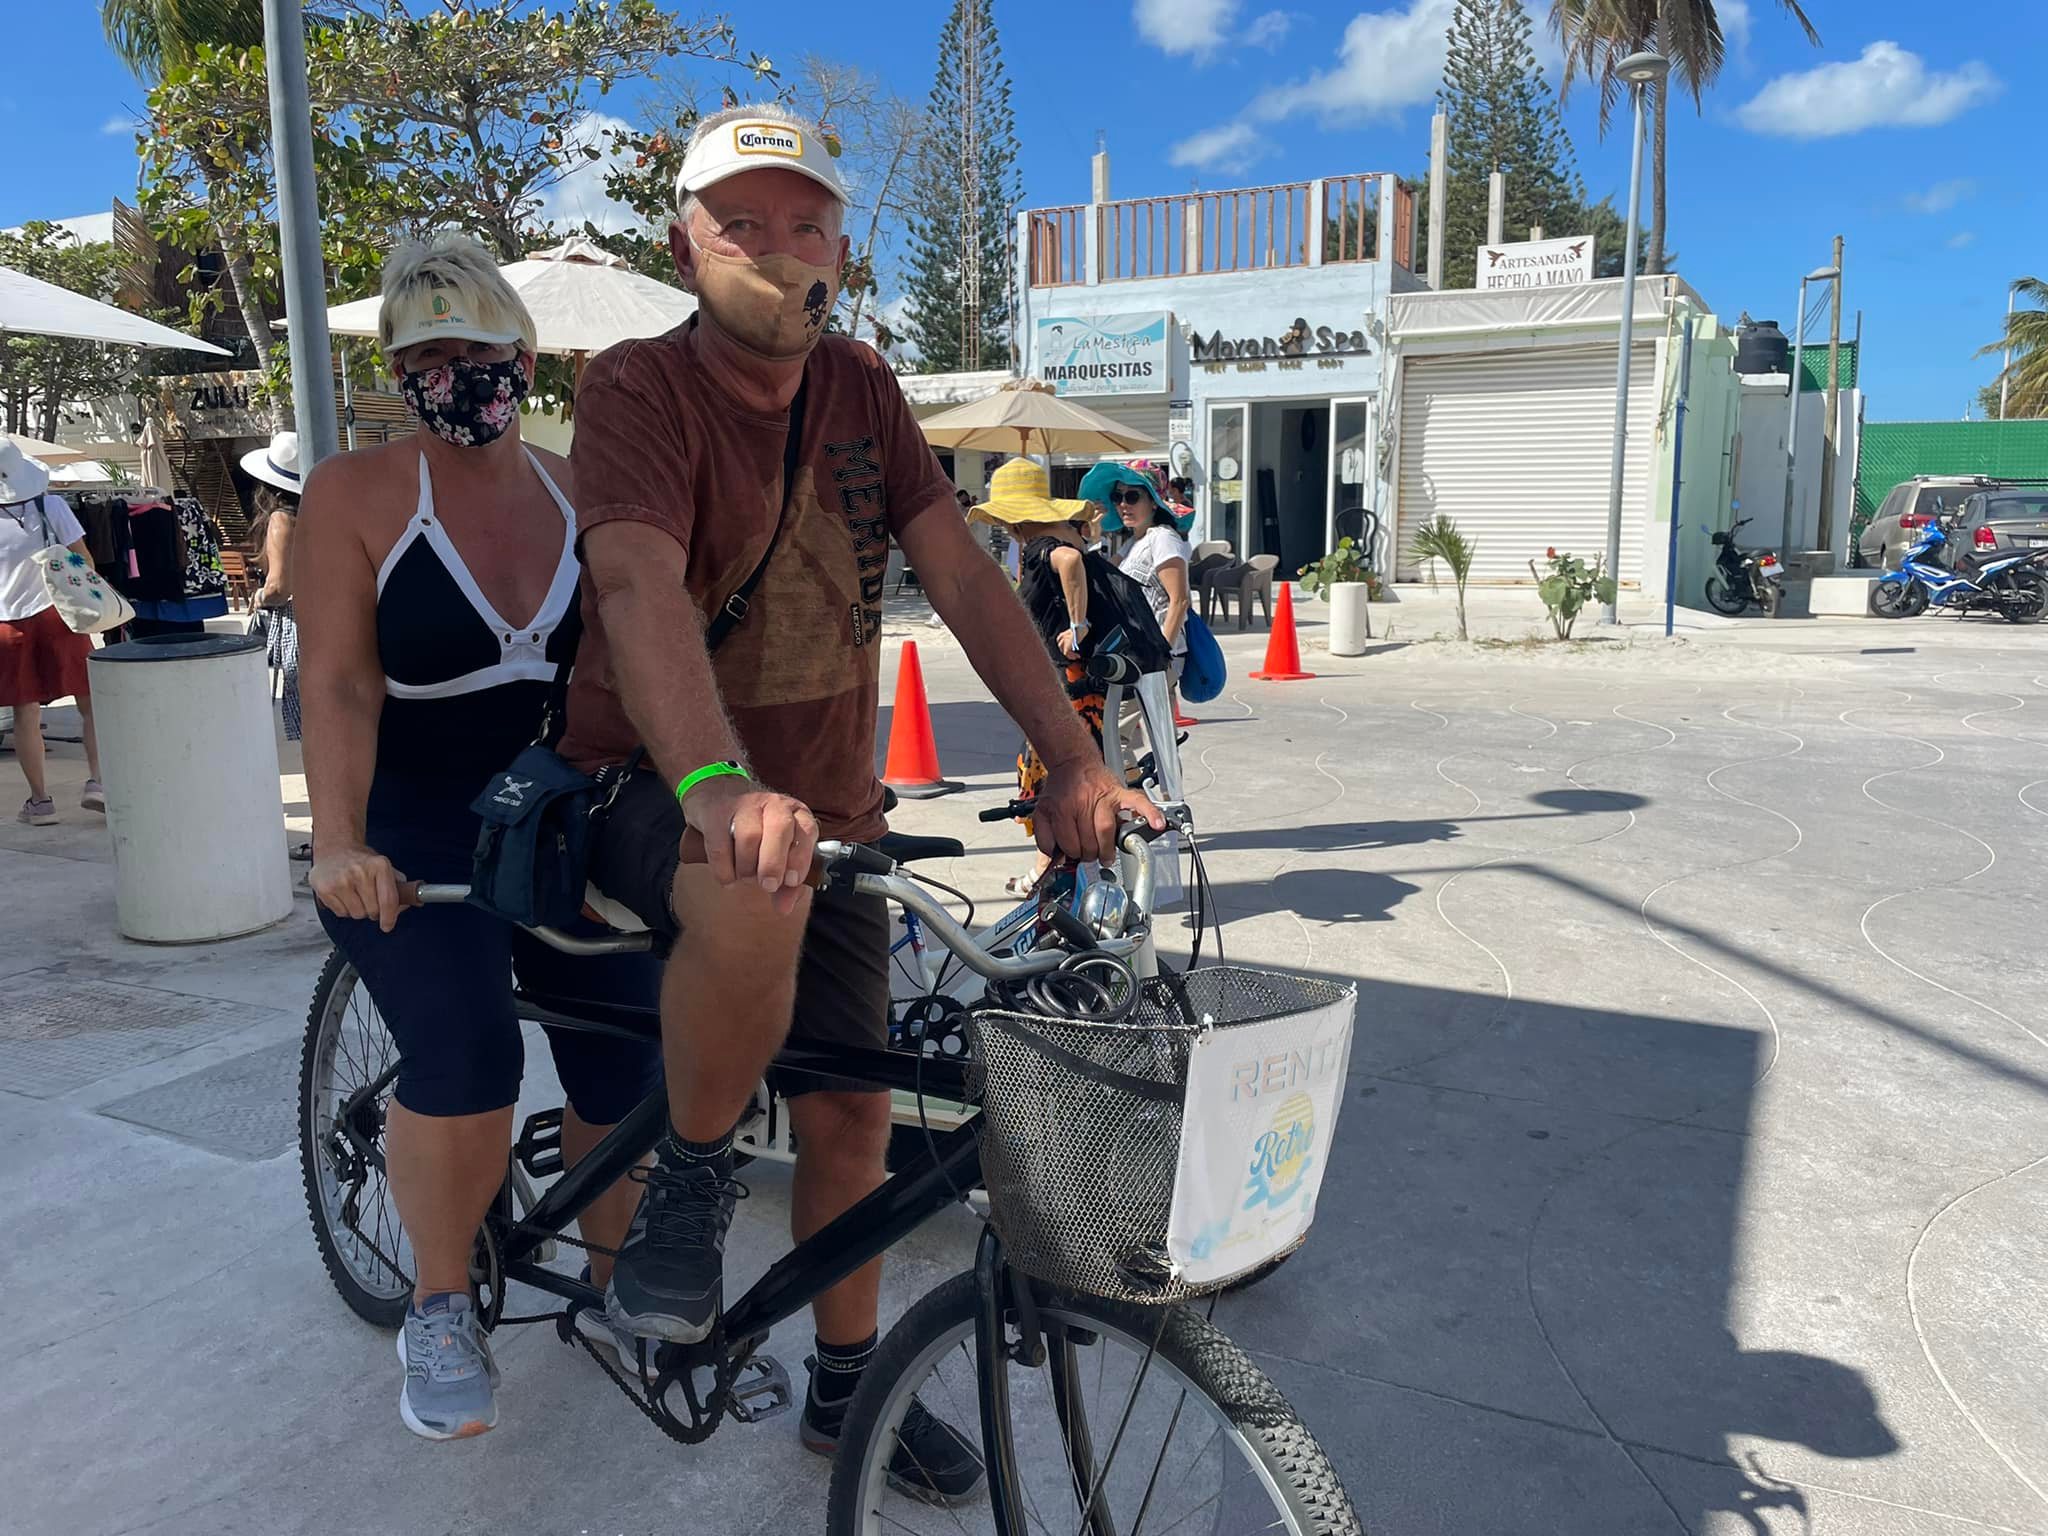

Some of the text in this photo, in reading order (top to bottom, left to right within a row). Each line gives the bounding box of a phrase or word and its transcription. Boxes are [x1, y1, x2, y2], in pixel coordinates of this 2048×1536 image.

[740, 133, 794, 149] Corona
[1499, 253, 1575, 269] ARTESANIAS
[1488, 272, 1531, 289] HECHO
[1547, 268, 1584, 286] MANO
[1192, 325, 1366, 360] Mayan Spa
[1044, 362, 1153, 380] MARQUESITAS
[824, 435, 889, 643] MERIDA
[851, 605, 862, 646] MEXICO
